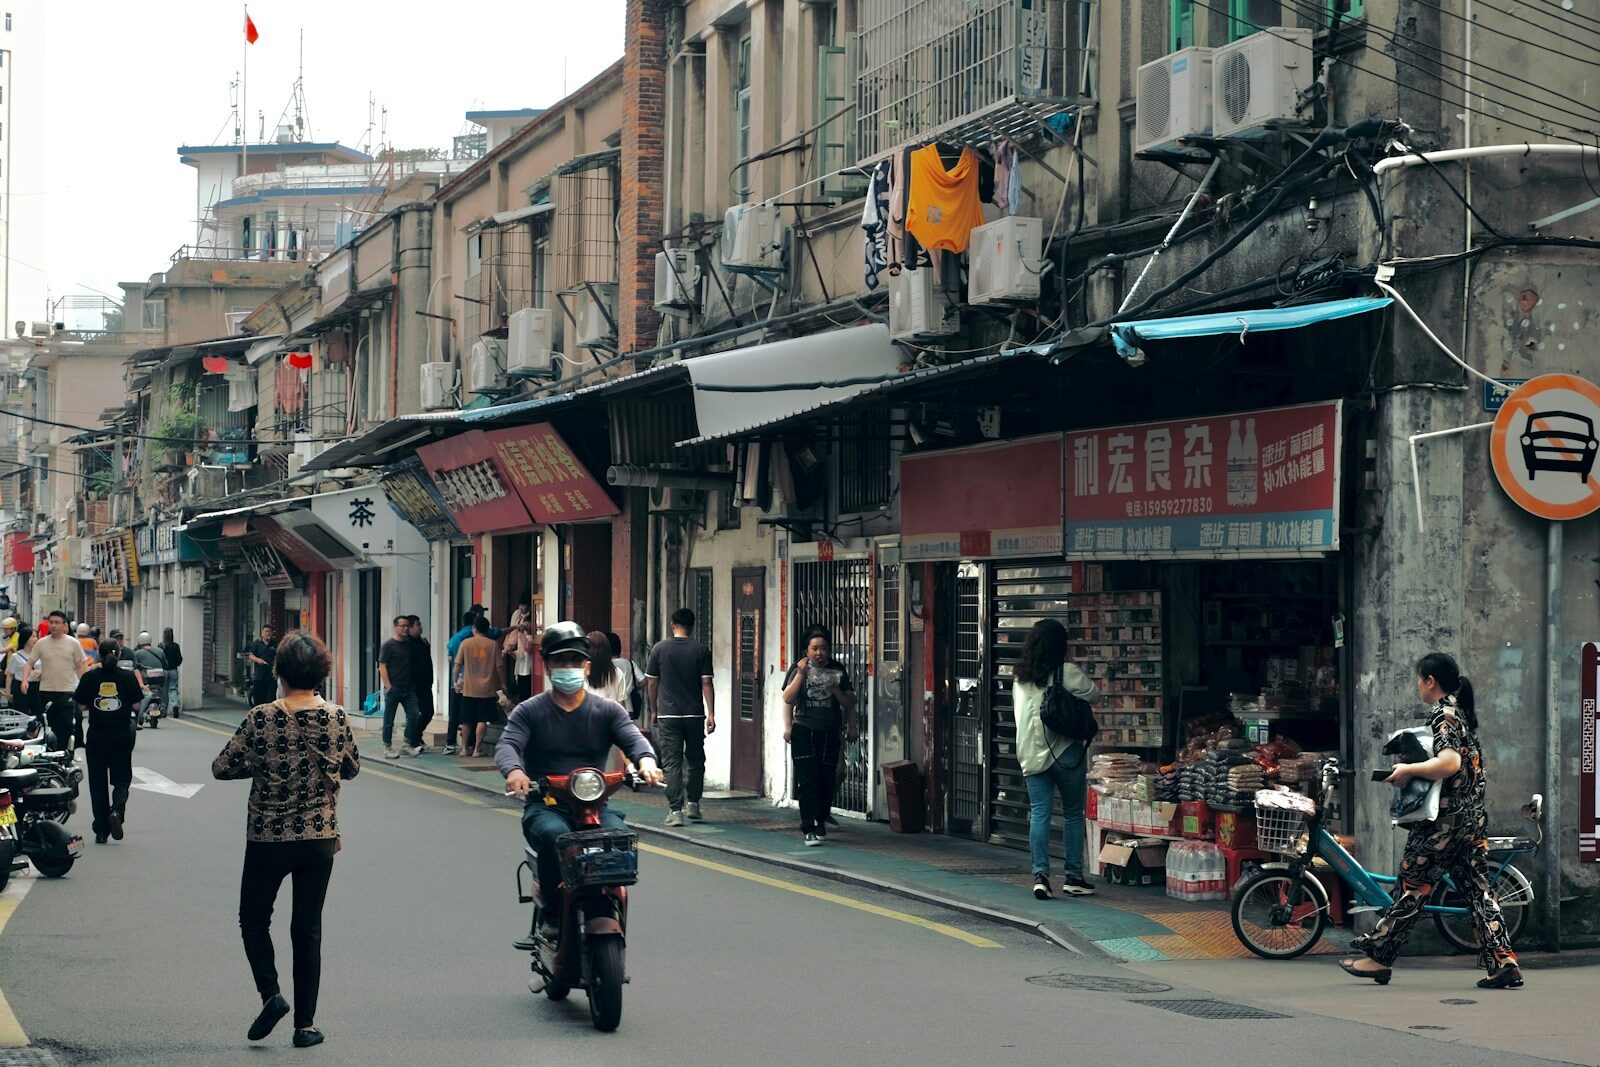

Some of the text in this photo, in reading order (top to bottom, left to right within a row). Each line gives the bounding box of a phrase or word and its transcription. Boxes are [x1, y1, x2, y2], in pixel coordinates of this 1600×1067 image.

[1290, 423, 1324, 457] 葡萄糖
[1074, 424, 1213, 496] 利宏食杂
[1263, 448, 1325, 493] 补水补能量
[348, 497, 376, 528] 茶
[1096, 527, 1123, 549] 葡萄糖
[1126, 525, 1171, 550] 补水补能量
[1227, 521, 1262, 546] 葡萄糖
[1266, 519, 1324, 546] 补水补能量
